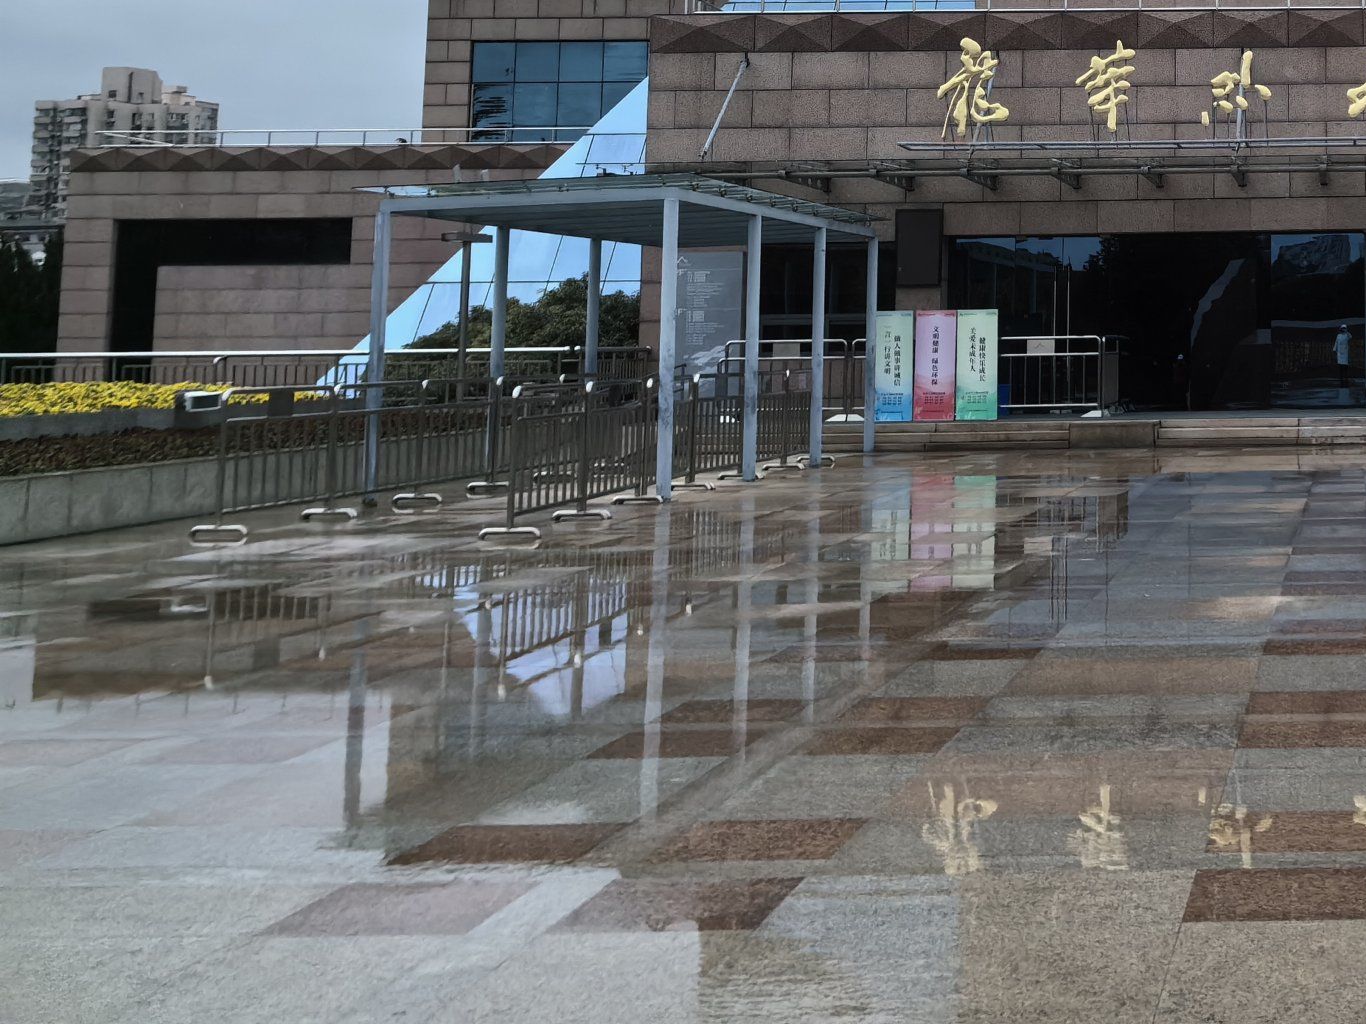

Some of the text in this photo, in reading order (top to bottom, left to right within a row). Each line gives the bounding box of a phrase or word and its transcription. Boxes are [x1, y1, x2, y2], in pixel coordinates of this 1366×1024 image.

[969, 327, 977, 372] 关爱未成年人
[931, 357, 939, 386] 绿色环保
